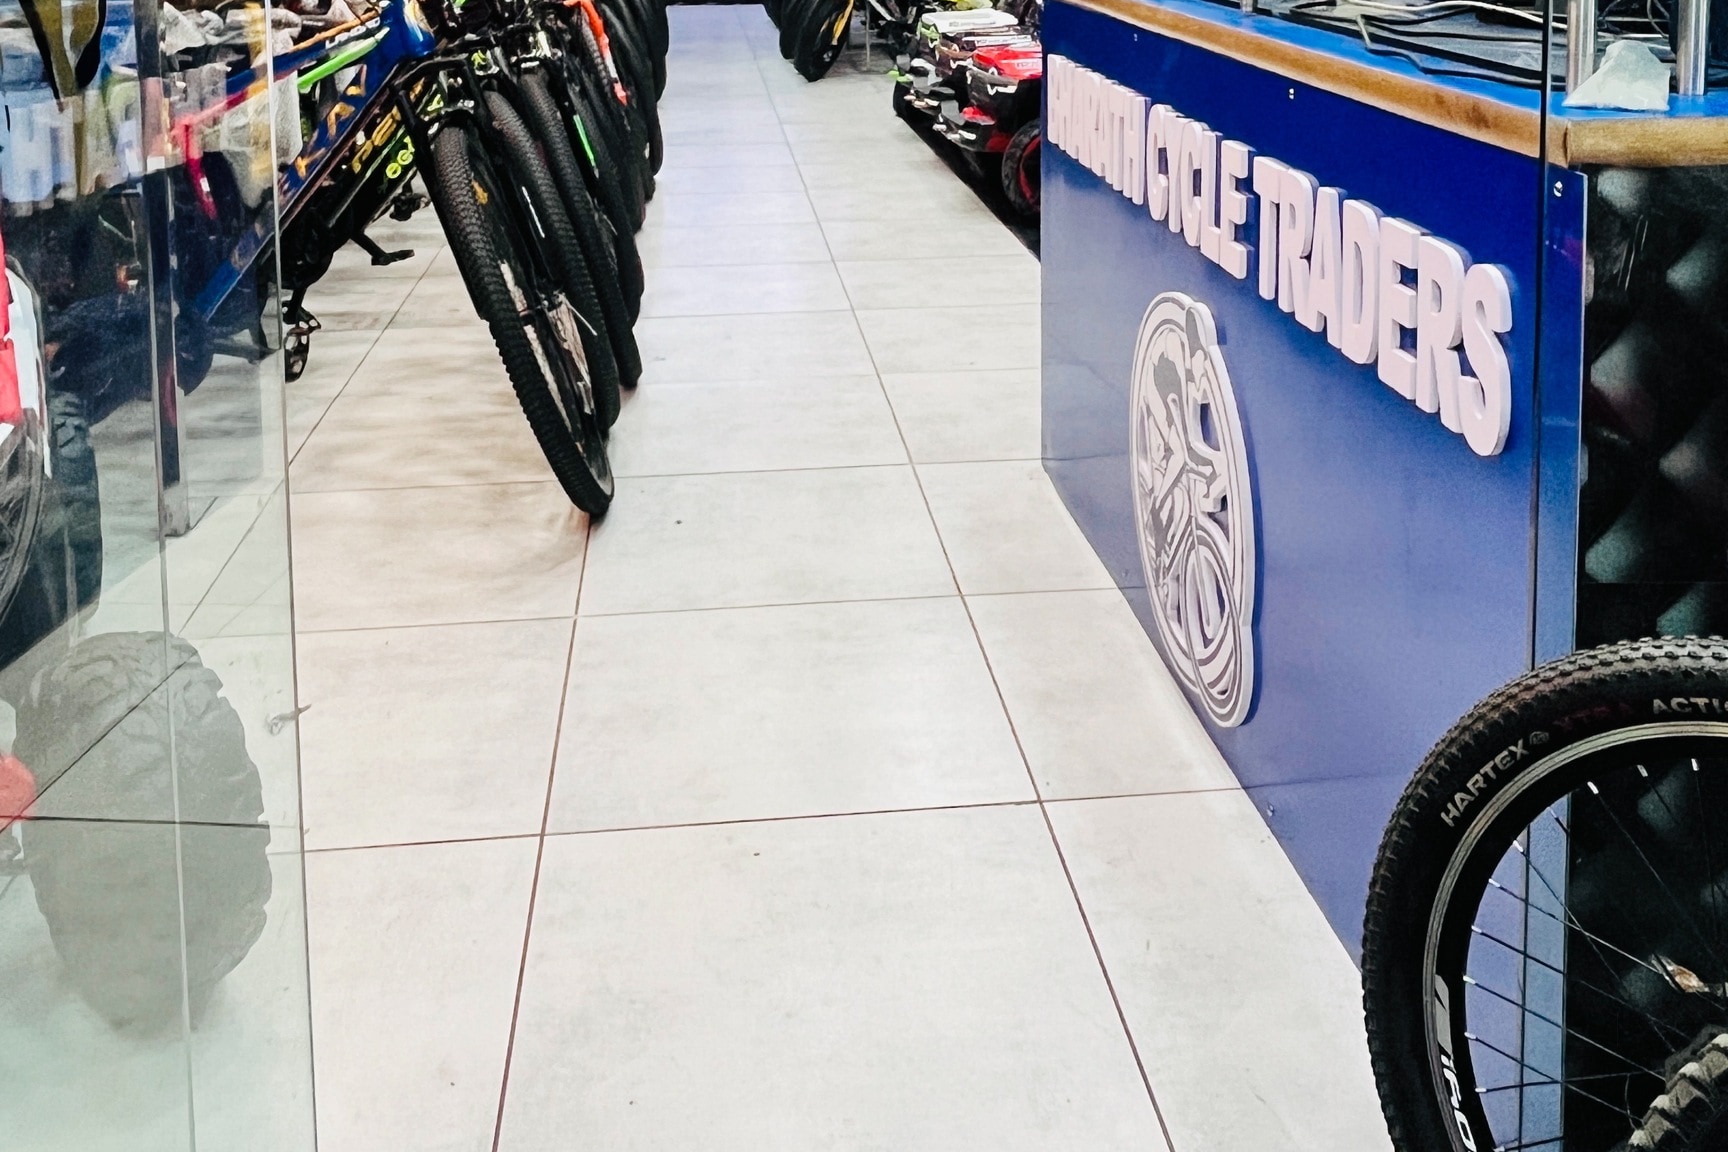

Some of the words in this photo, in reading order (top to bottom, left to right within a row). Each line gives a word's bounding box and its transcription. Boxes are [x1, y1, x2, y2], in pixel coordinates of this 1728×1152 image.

[1147, 104, 1250, 280] CYCLE
[1253, 156, 1515, 456] TRADERS
[1440, 738, 1529, 827] HARTEX
